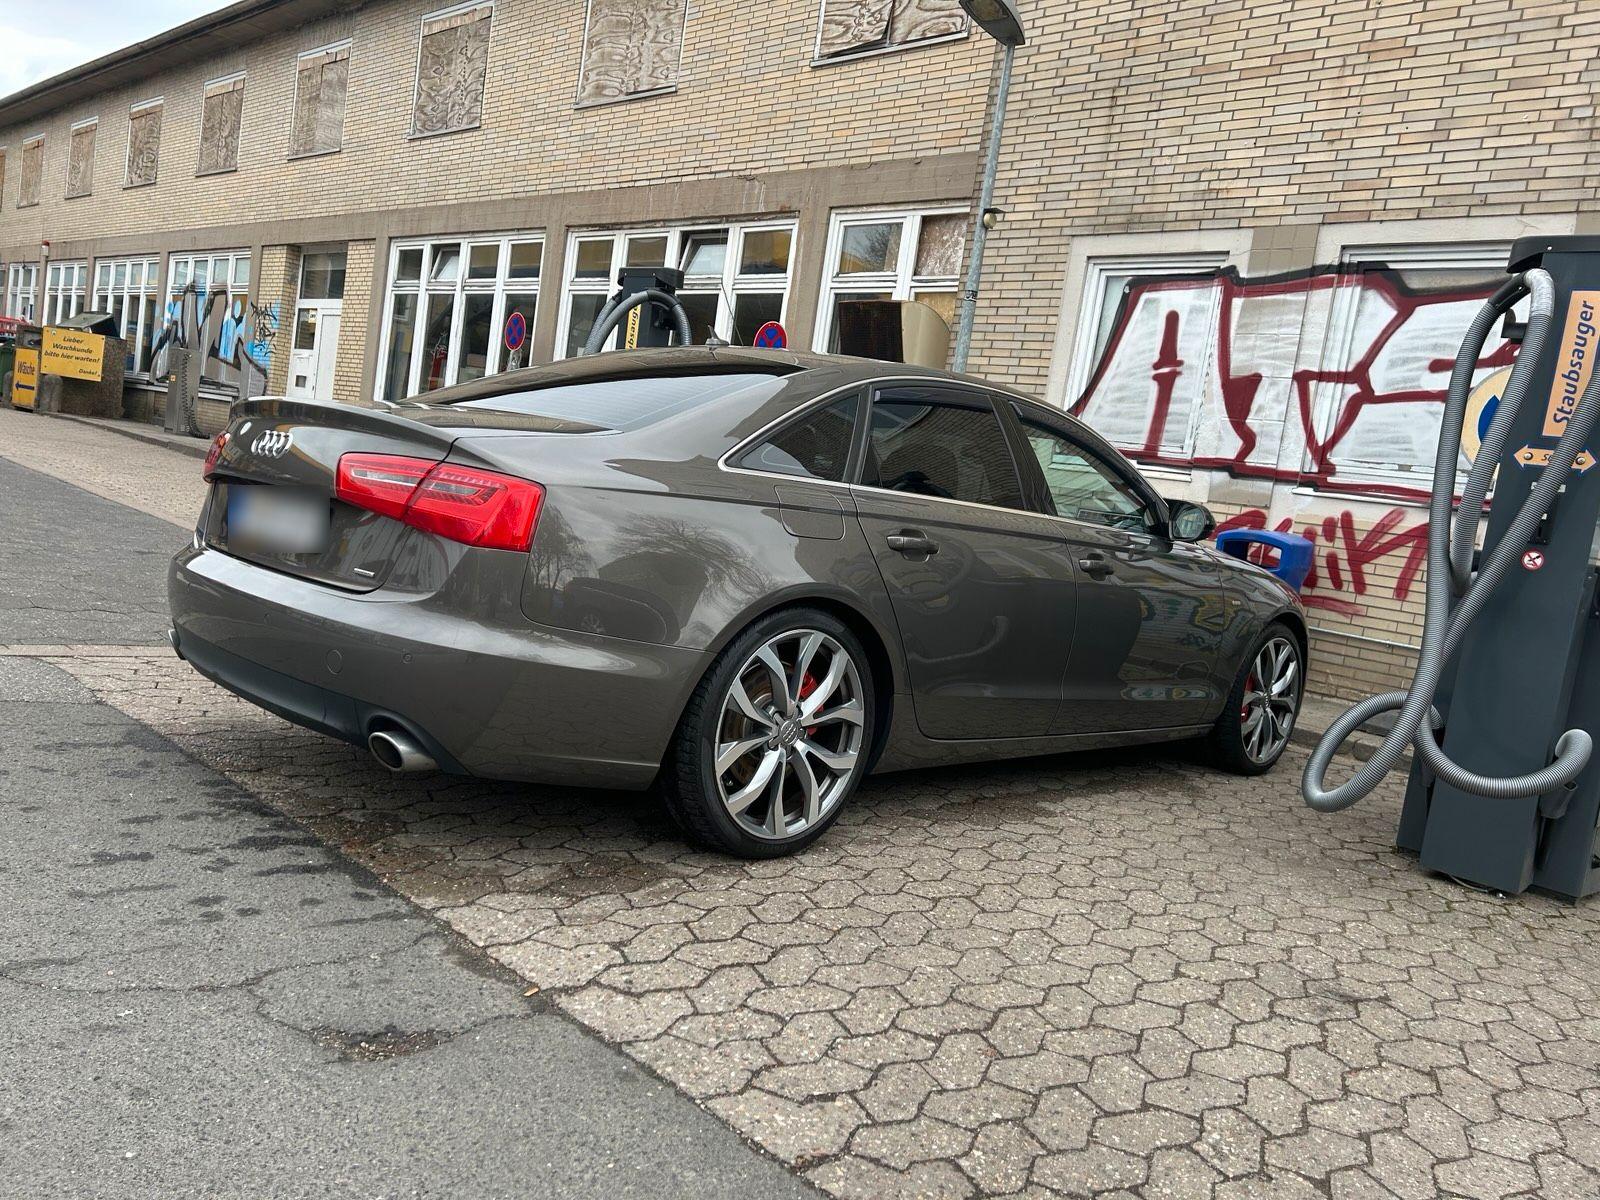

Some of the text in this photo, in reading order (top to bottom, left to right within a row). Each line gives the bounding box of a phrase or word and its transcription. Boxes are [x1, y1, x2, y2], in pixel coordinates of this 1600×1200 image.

[63, 336, 84, 344] Lieber
[52, 343, 93, 354] Waschkunde
[44, 350, 60, 358] bitte
[1553, 300, 1595, 424] Staubsauger
[78, 368, 98, 376] Danke!
